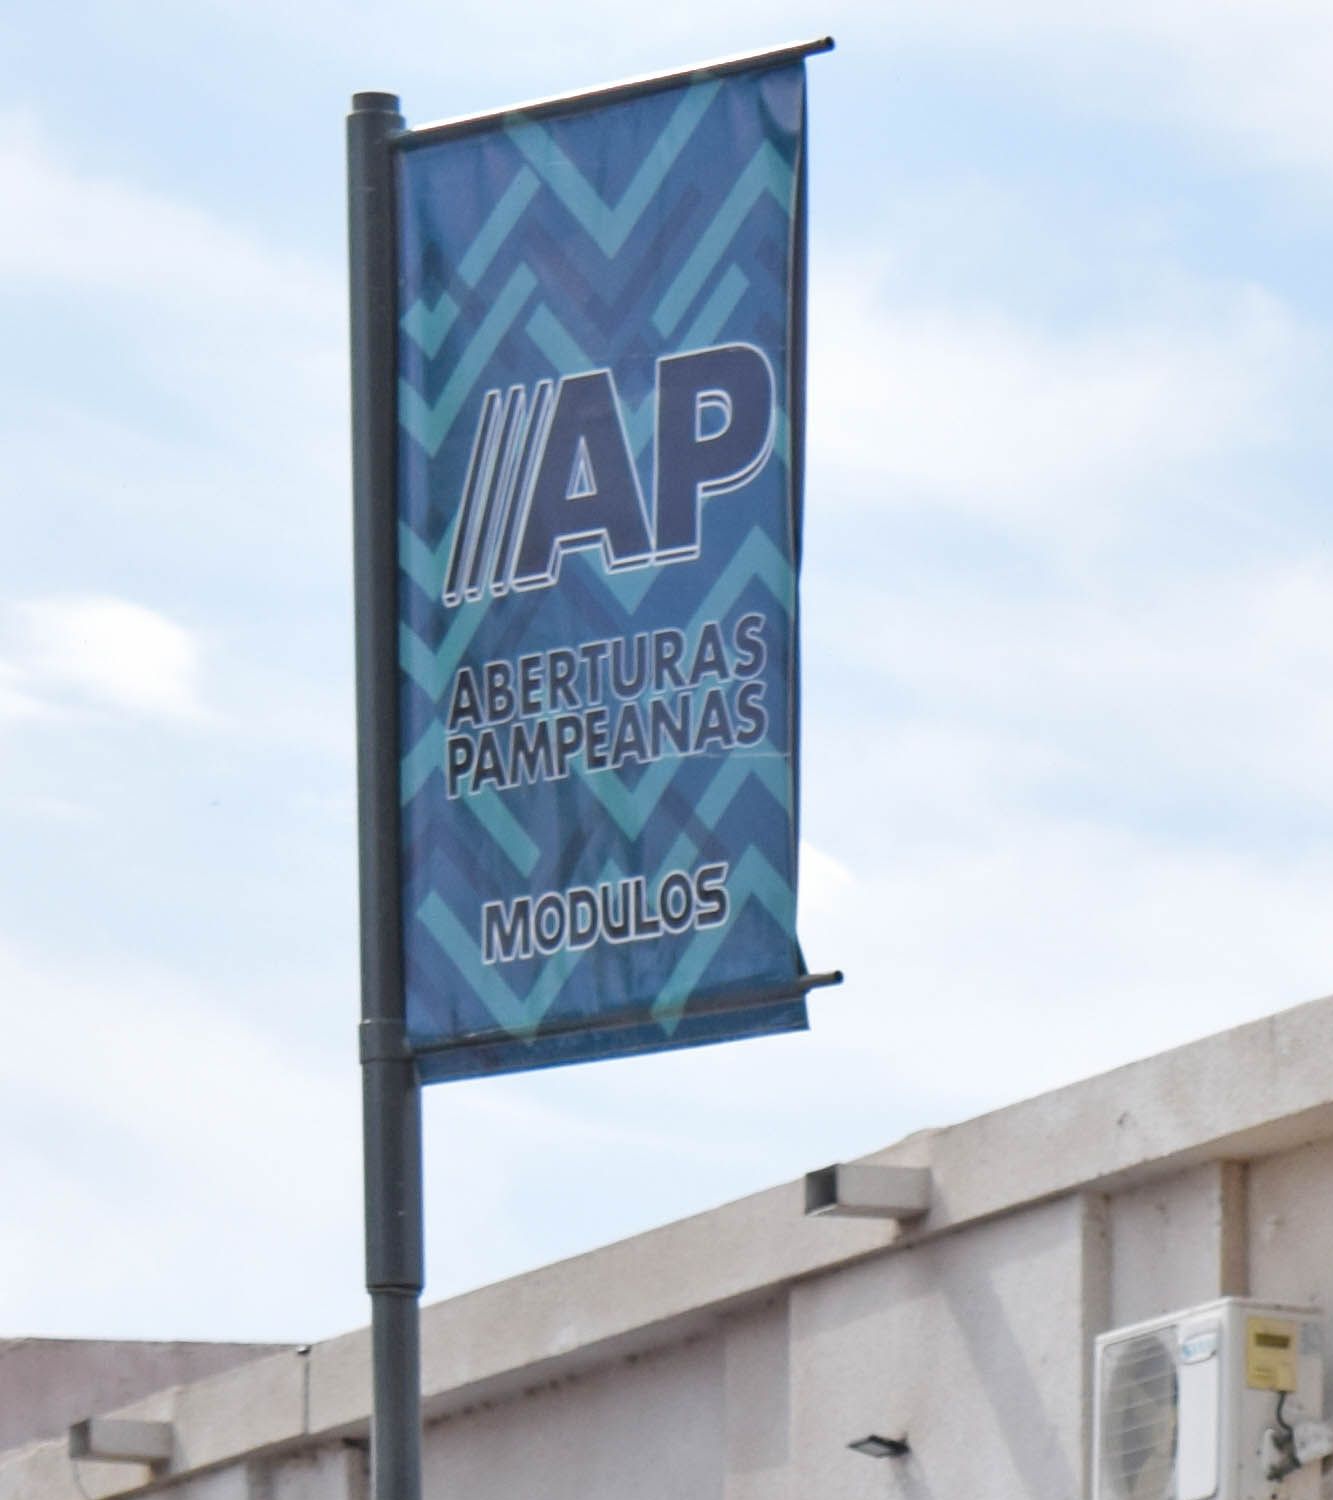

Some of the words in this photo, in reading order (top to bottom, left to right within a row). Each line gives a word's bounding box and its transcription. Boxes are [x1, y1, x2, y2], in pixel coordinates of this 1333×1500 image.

[447, 612, 767, 734] ABERTURAS
[446, 679, 768, 799] PAMPEANAS
[483, 862, 728, 964] MODULOS
